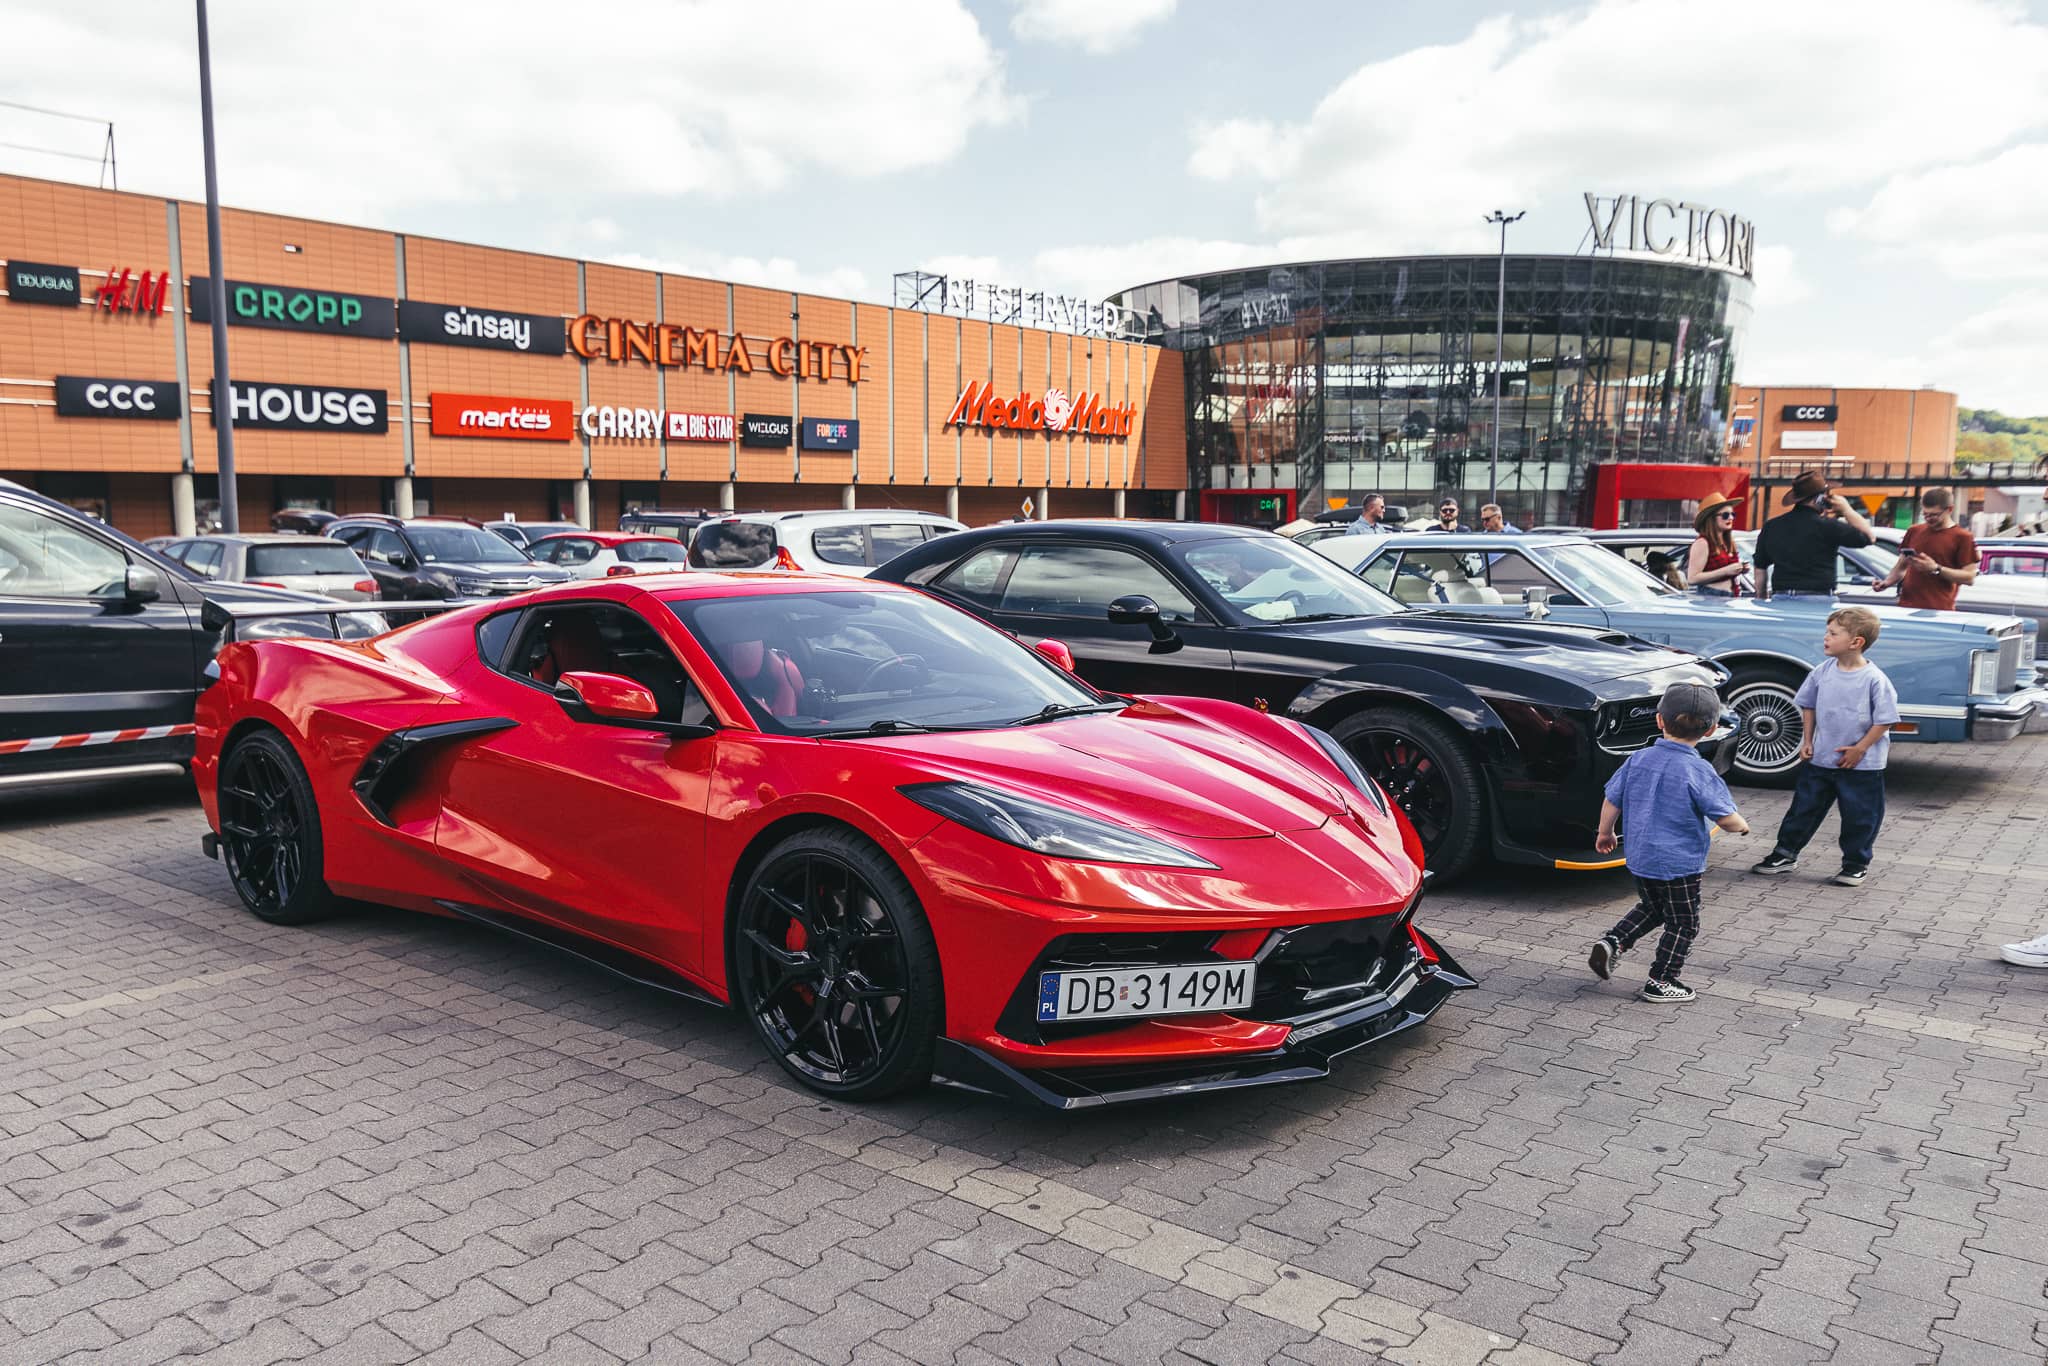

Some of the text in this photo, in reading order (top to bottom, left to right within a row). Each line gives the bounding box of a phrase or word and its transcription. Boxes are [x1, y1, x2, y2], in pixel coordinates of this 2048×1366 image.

[96, 265, 169, 317] H&M
[235, 286, 363, 326] CROPP
[444, 306, 531, 349] sinsay
[569, 314, 866, 383] CINEMA CITY
[85, 383, 157, 411] CCC
[1796, 407, 1826, 420] CCC
[460, 407, 551, 430] martes
[580, 405, 666, 440] CARRY
[689, 416, 734, 439] BIG STAR
[1042, 1002, 1056, 1013] PL
[1067, 968, 1246, 1015] DB 3149M
